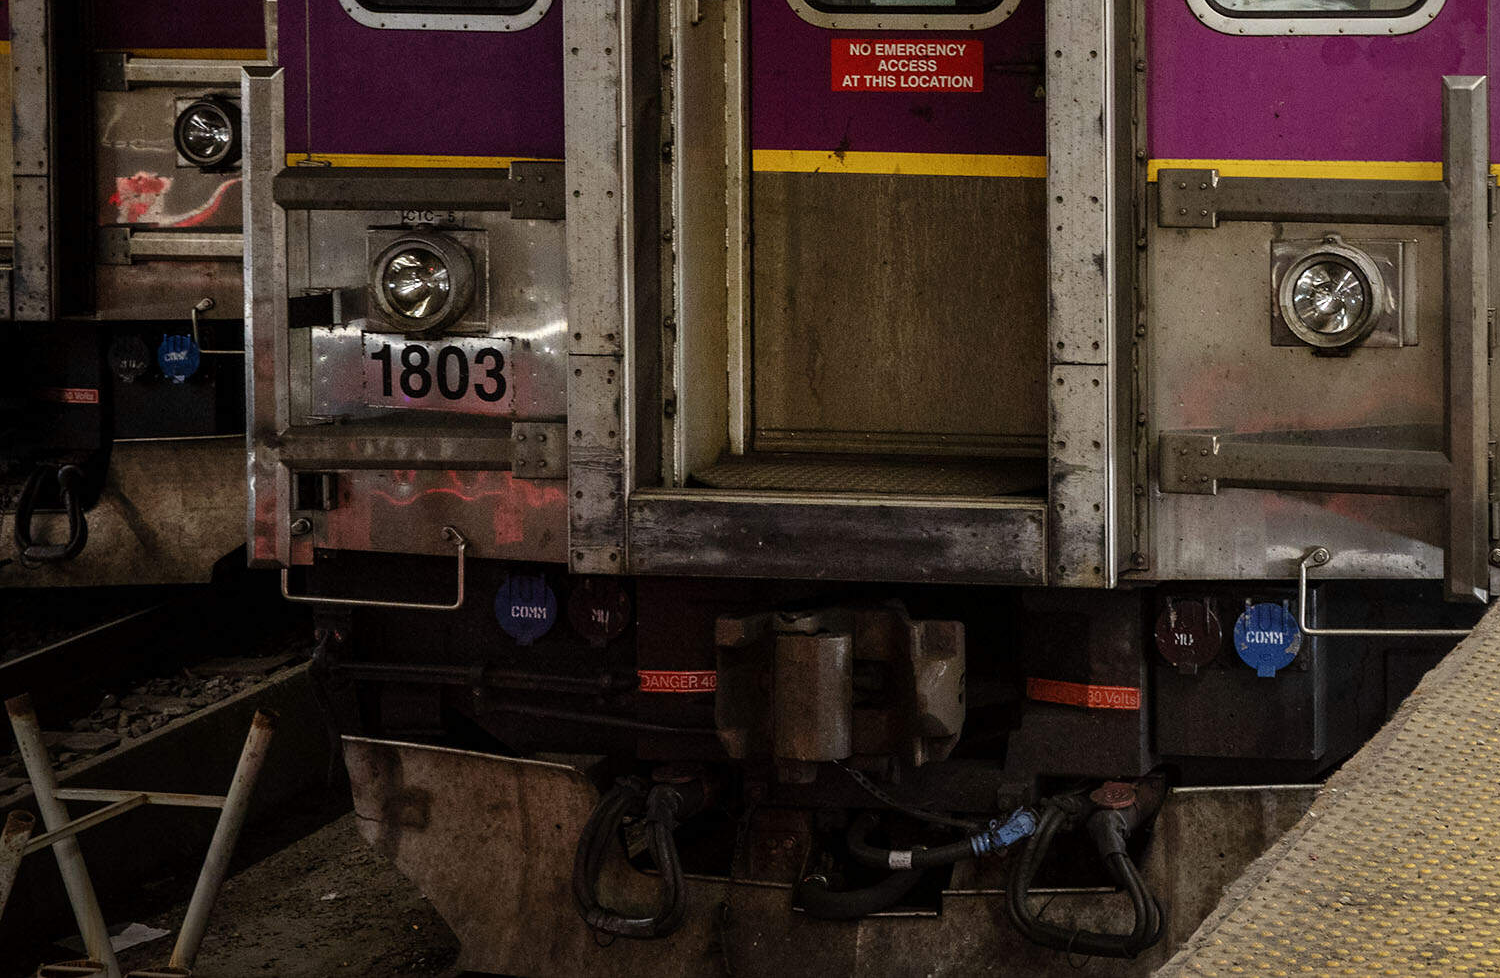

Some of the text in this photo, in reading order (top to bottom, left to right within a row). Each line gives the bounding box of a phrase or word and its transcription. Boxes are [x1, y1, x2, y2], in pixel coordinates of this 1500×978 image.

[849, 43, 967, 57] NO EMERGENCY
[877, 59, 938, 72] ACCESS
[842, 75, 974, 88] AT THIS LOCATION
[371, 344, 507, 402] 1803
[511, 605, 547, 621] COMM
[1245, 630, 1284, 645] COMM
[641, 674, 698, 690] DANGER
[1104, 691, 1137, 706] Volts
